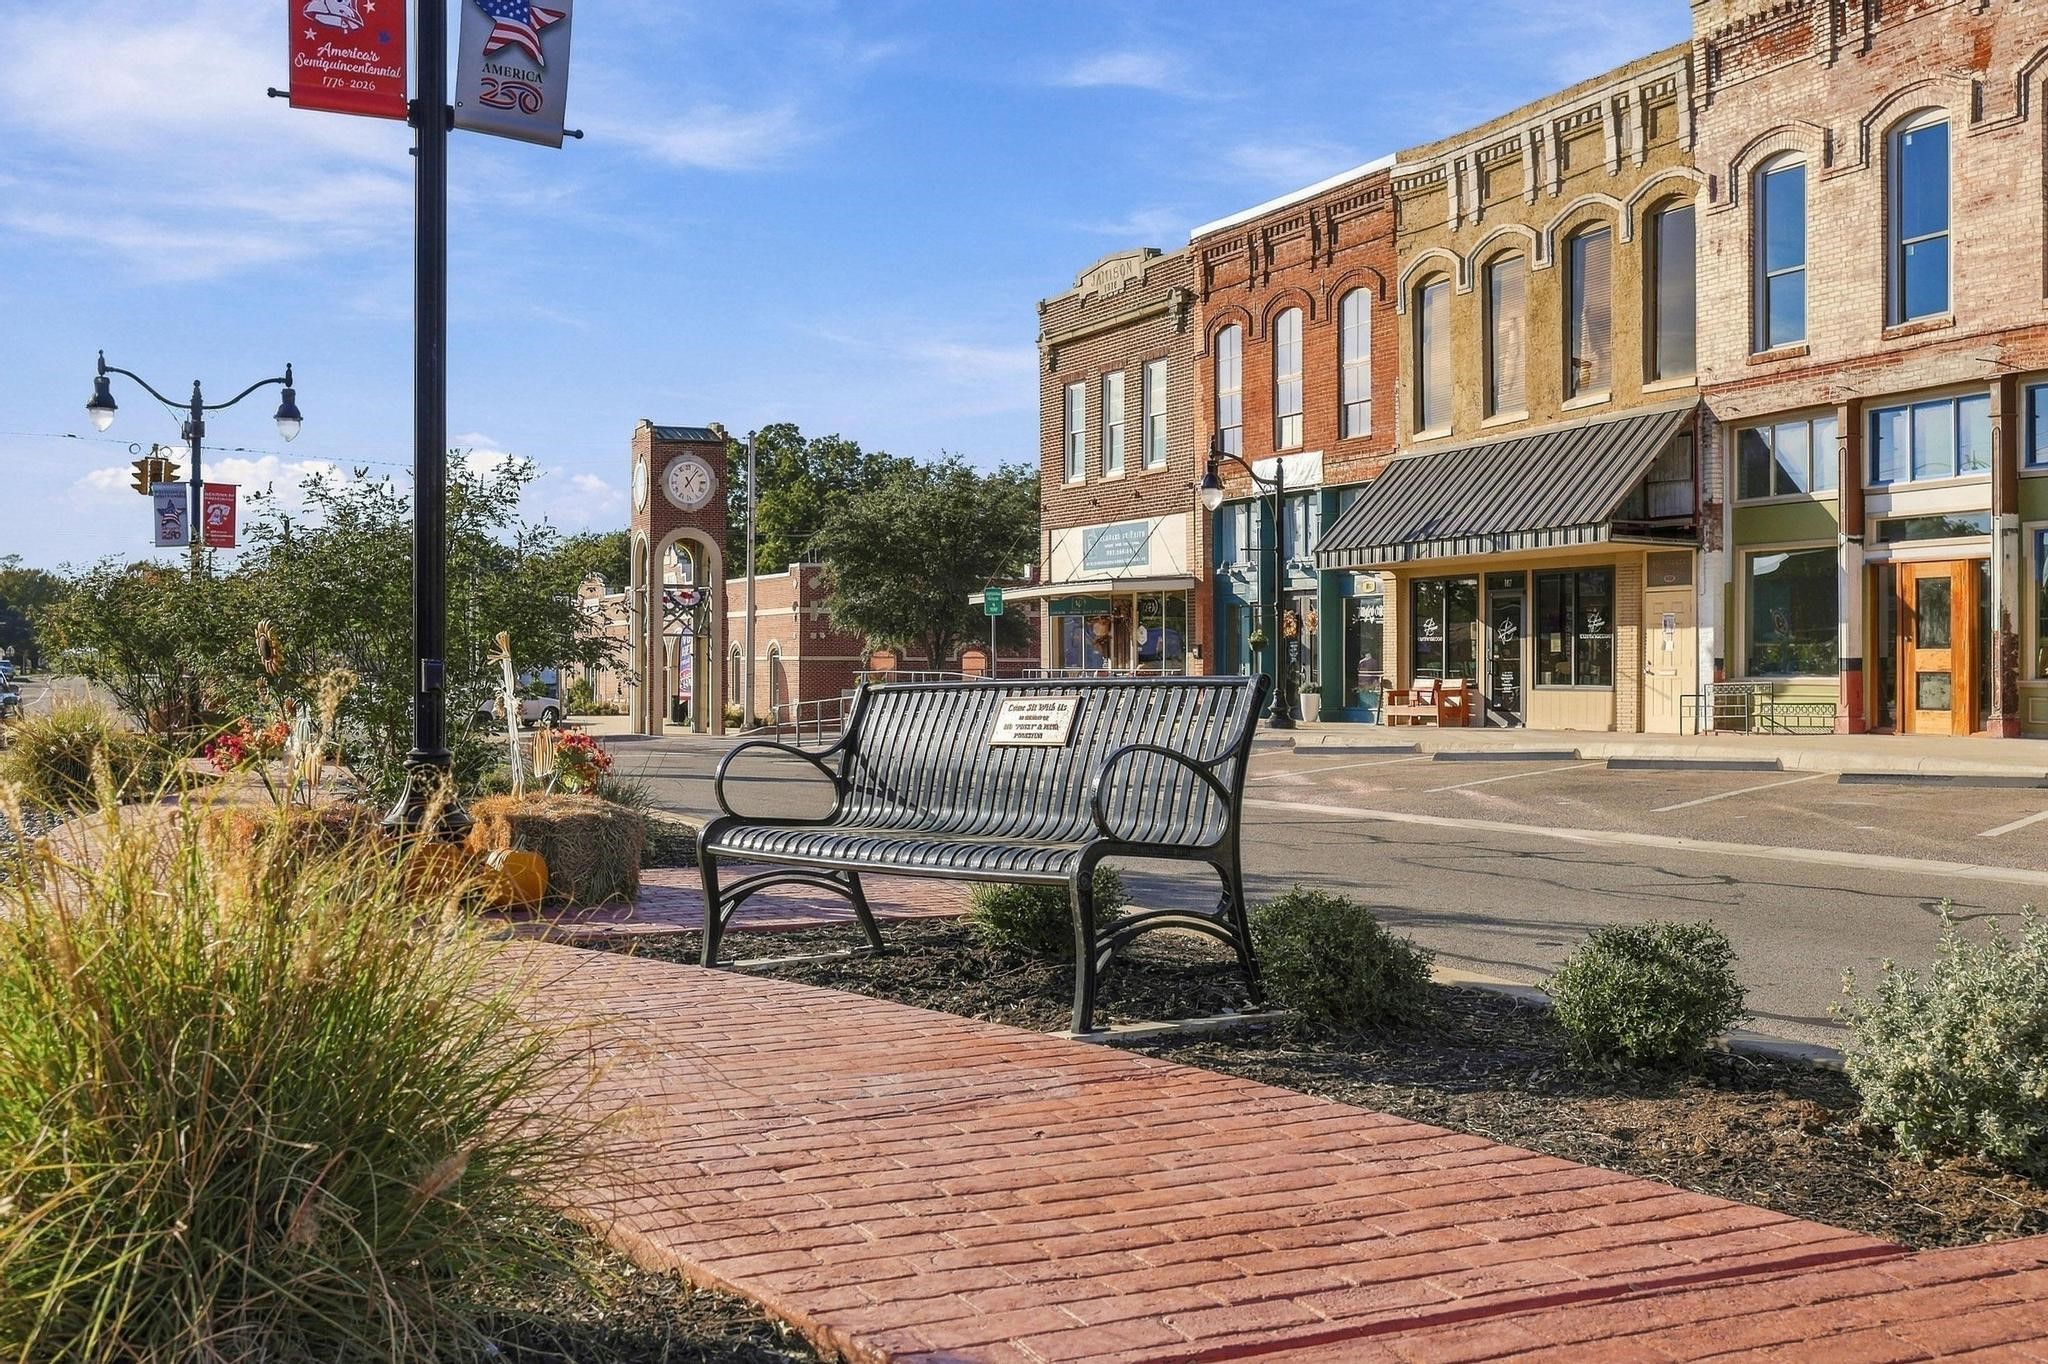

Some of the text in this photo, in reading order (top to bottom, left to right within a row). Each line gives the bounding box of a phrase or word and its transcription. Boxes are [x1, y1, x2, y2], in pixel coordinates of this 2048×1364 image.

[317, 42, 380, 62] America's
[294, 52, 401, 78] Semiquincentennial
[482, 62, 544, 84] AMERICA
[479, 76, 544, 114] 250
